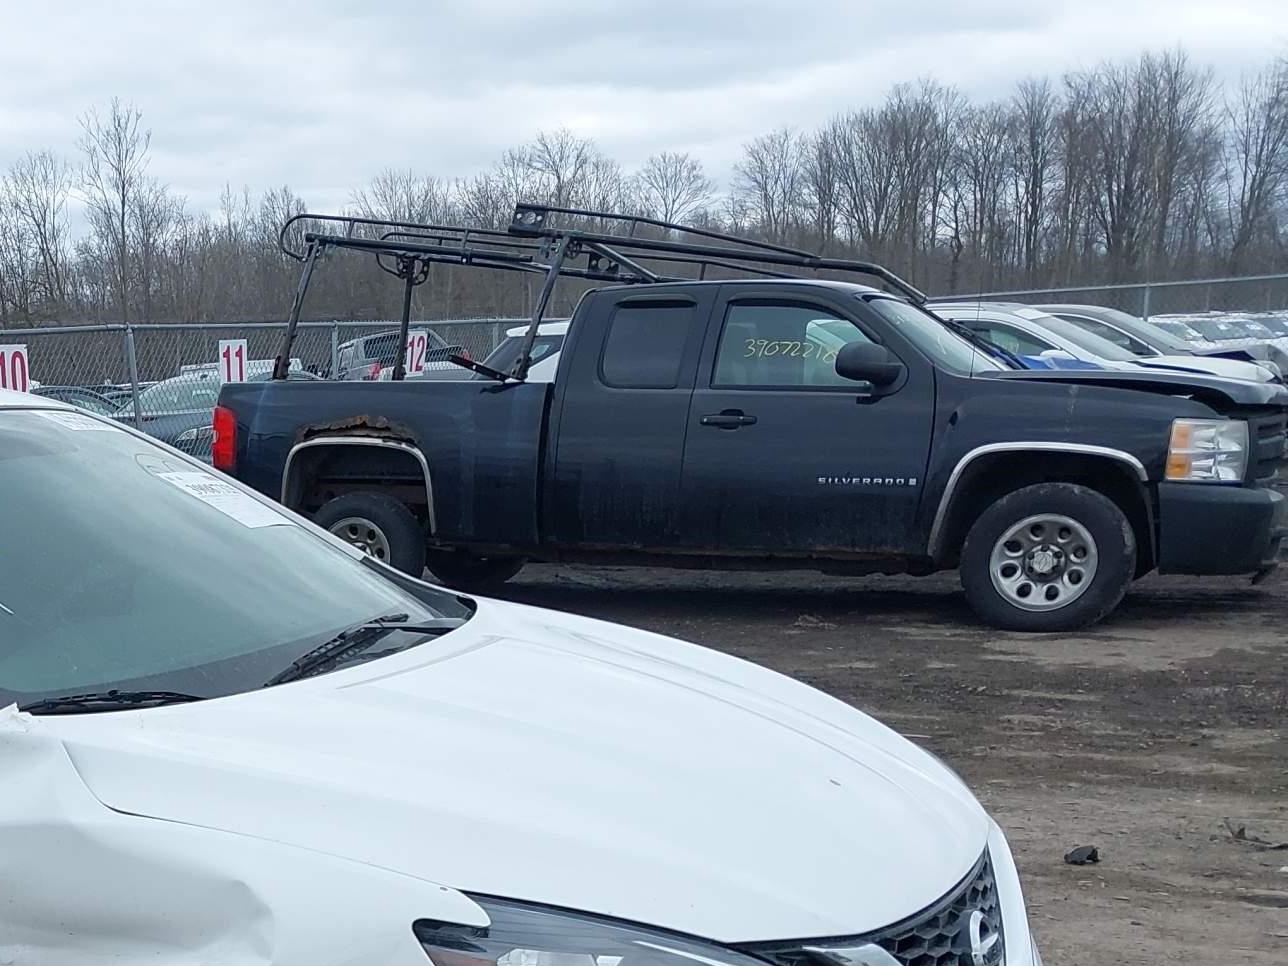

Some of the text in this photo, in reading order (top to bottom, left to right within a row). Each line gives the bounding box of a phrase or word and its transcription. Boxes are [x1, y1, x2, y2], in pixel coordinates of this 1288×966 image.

[222, 344, 244, 382] 11
[408, 335, 426, 372] 12
[816, 476, 906, 487] SILVERADO
